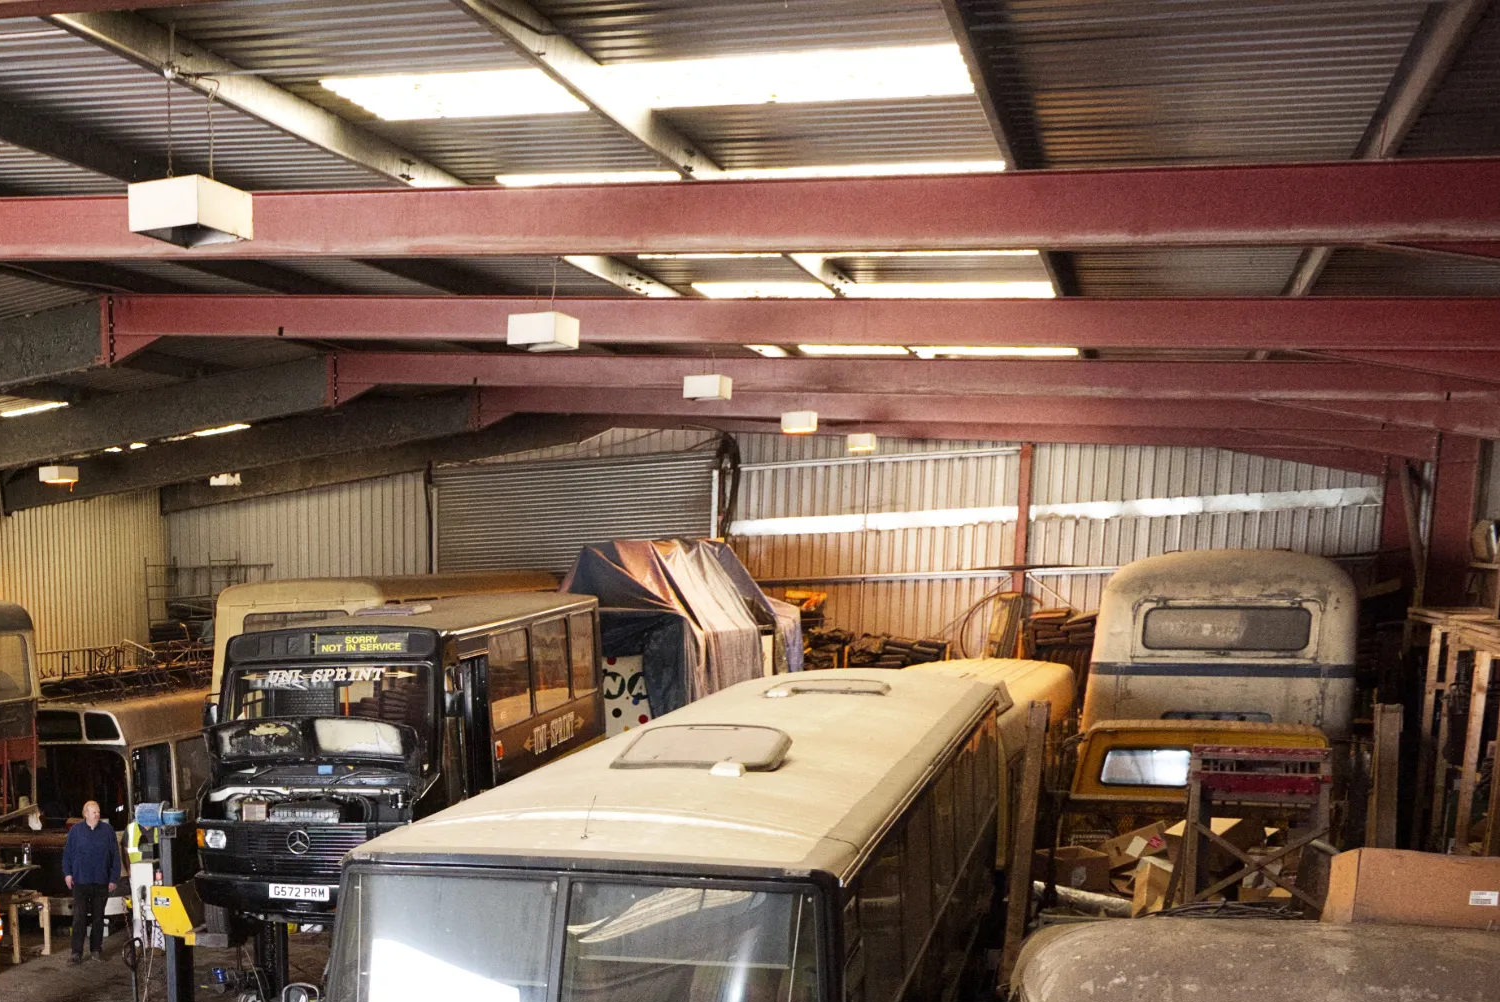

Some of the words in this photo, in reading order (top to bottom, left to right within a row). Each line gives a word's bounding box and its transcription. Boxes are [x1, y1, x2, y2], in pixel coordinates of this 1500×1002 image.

[345, 635, 379, 644] SORRY
[321, 644, 342, 652] NOT
[346, 643, 356, 652] IN
[359, 642, 401, 651] SERVICE
[268, 669, 303, 684] UNI
[310, 667, 386, 683] SPRINT
[603, 675, 647, 696] NA
[533, 723, 547, 755] UNI
[550, 711, 575, 749] SPRINT
[273, 886, 301, 898] G572
[304, 886, 325, 898] PRM
